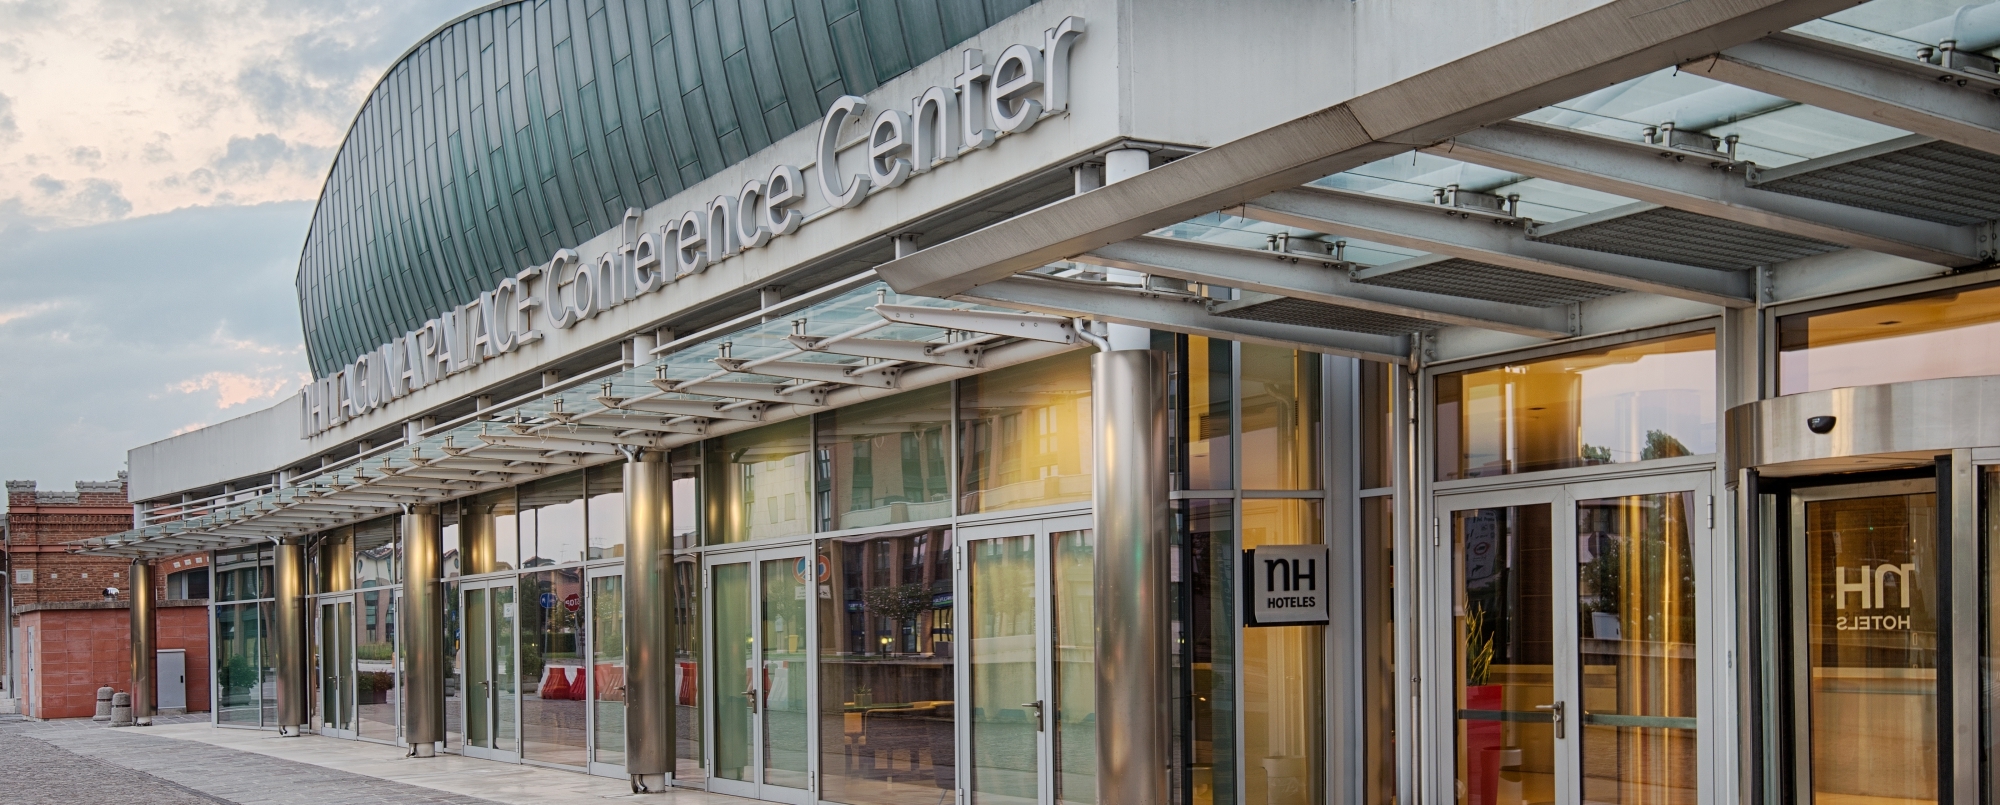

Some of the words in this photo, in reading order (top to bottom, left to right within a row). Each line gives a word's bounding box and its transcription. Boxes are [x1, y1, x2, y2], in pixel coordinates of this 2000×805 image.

[328, 331, 425, 429] LAGUNA
[424, 265, 544, 385] PALACE
[545, 164, 804, 330] Conference
[816, 15, 1085, 209] Center
[1264, 558, 1316, 592] nH
[1267, 596, 1316, 609] HOTELES
